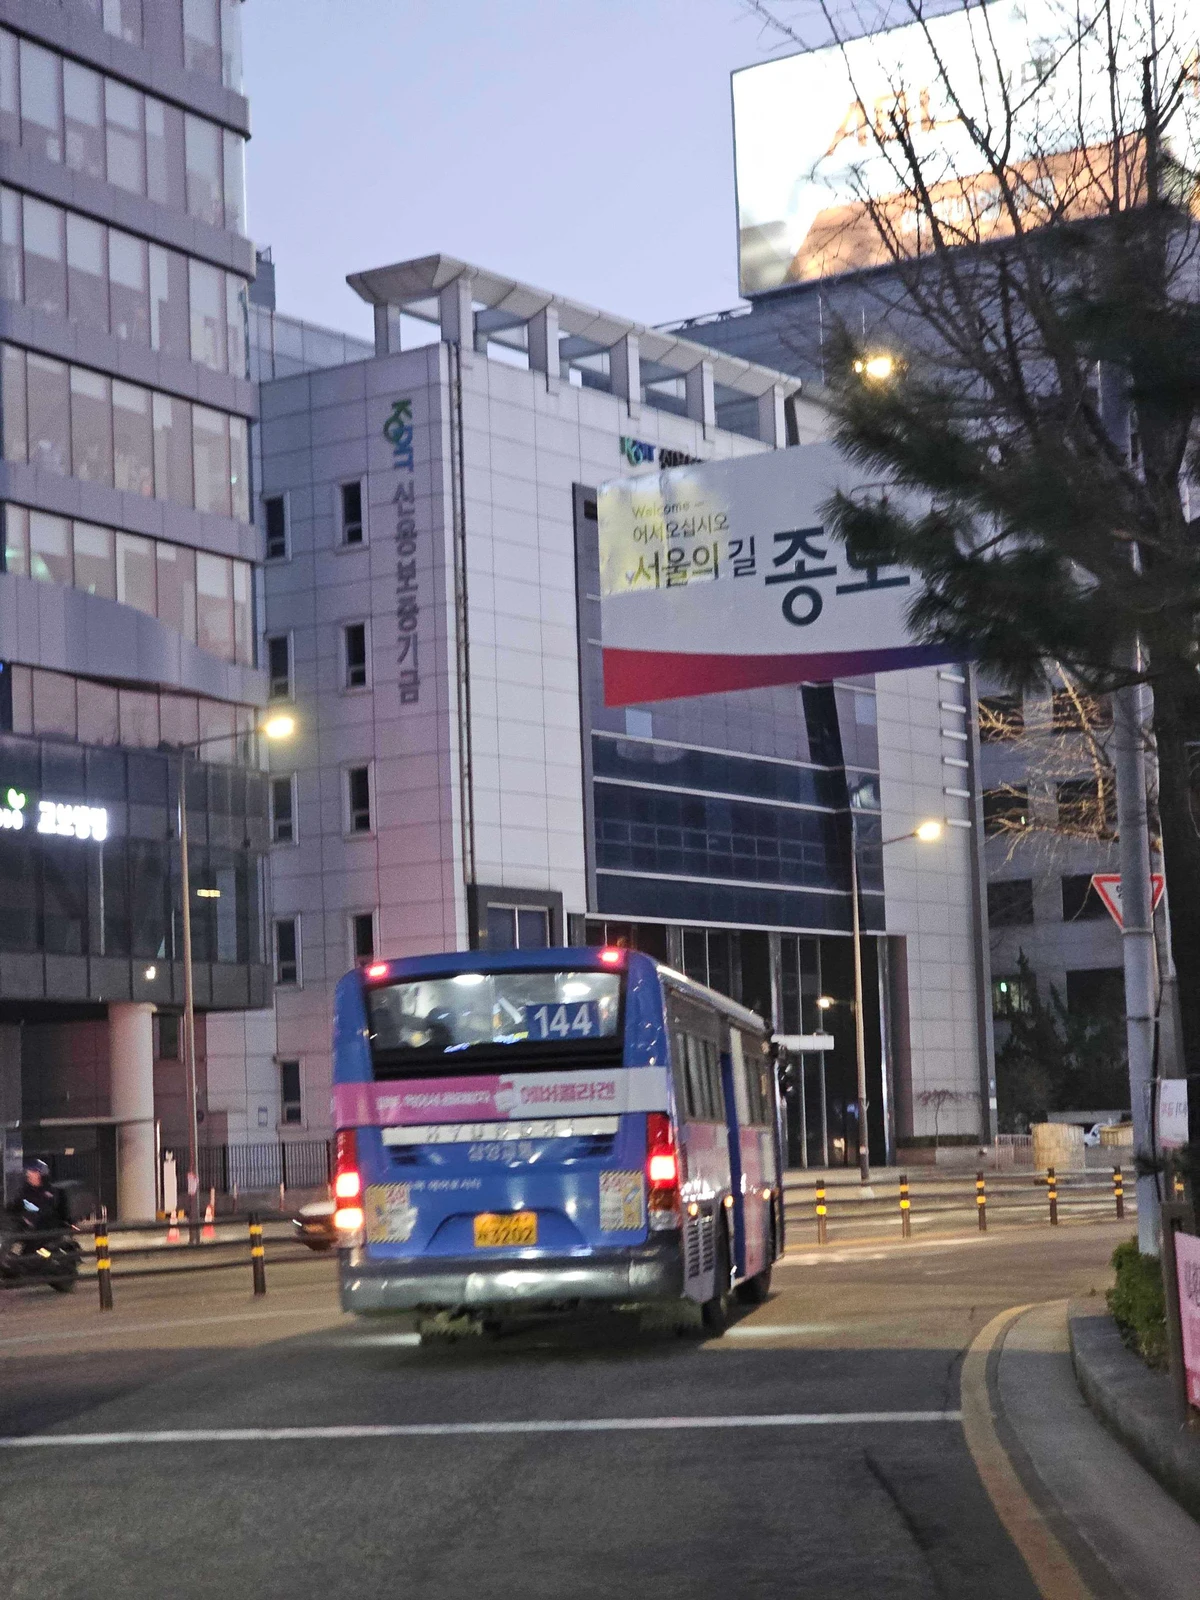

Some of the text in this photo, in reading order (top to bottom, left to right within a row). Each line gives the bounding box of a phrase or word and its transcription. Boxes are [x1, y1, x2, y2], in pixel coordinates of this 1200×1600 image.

[632, 542, 719, 589] 서울의
[728, 535, 757, 578] 길
[391, 479, 421, 705] 신용보증기금
[533, 1003, 593, 1039] 144
